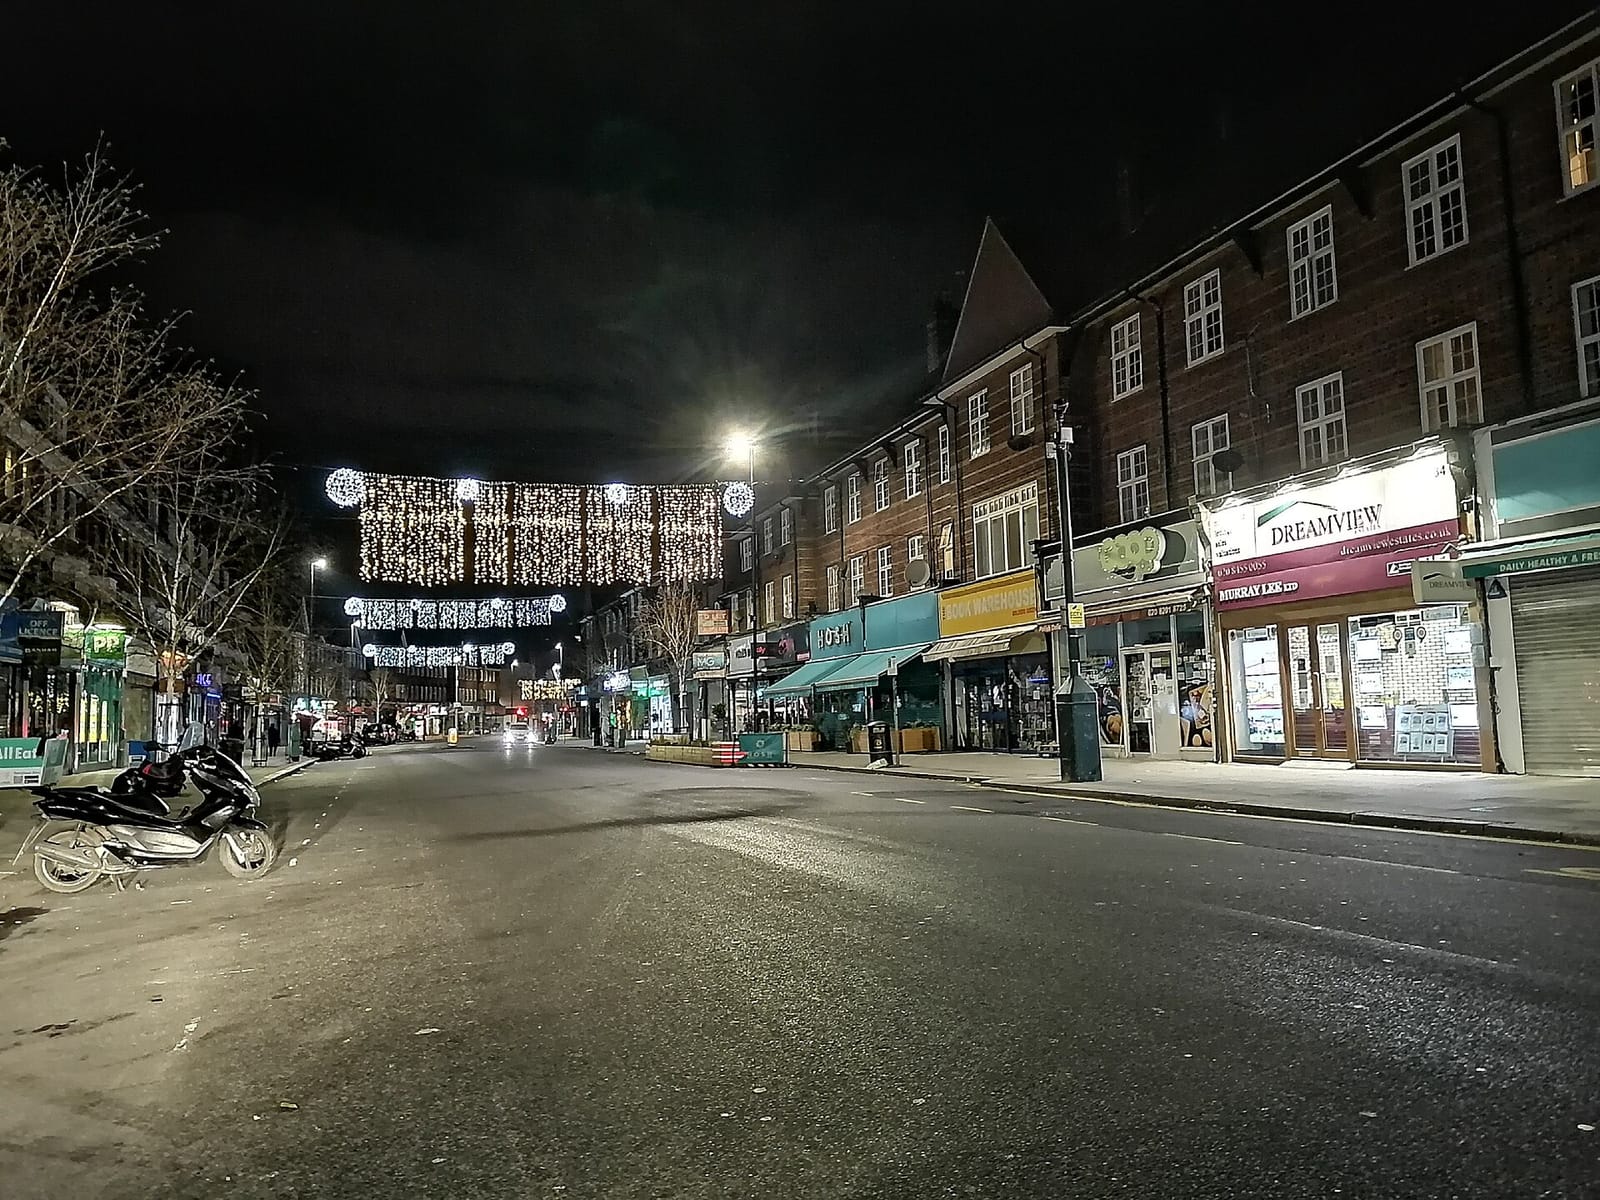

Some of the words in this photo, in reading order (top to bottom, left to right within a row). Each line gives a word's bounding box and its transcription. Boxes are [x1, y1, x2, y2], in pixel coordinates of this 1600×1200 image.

[1271, 503, 1383, 546] DREAMVIEW
[1500, 561, 1526, 572] DAILY
[1528, 555, 1568, 569] HEALTHY
[1219, 584, 1261, 602] MURRAY
[1262, 580, 1283, 596] LEE
[1283, 582, 1300, 592] LTD
[945, 600, 973, 621] BOOK
[973, 586, 1035, 616] WAREHOUSE
[18, 627, 59, 636] LICENCE
[29, 620, 49, 628] OFF
[817, 622, 850, 650] HOSH
[15, 748, 38, 760] Eat
